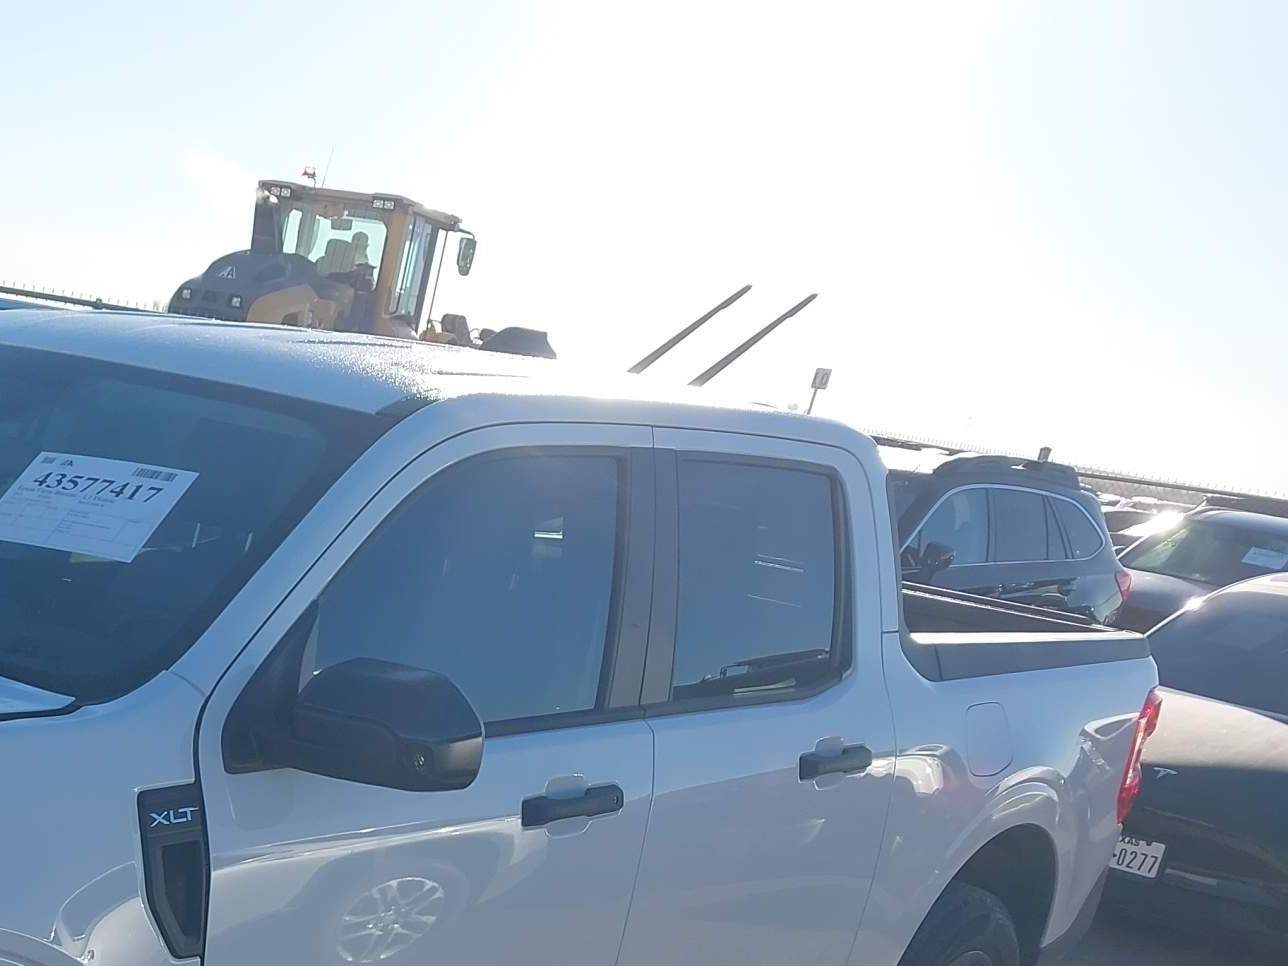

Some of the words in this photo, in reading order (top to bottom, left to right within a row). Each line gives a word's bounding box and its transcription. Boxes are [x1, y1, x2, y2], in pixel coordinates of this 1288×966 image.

[31, 471, 164, 504] 43577417
[149, 806, 199, 828] XLT
[1119, 835, 1140, 847] XAS
[1116, 847, 1159, 874] 0277
